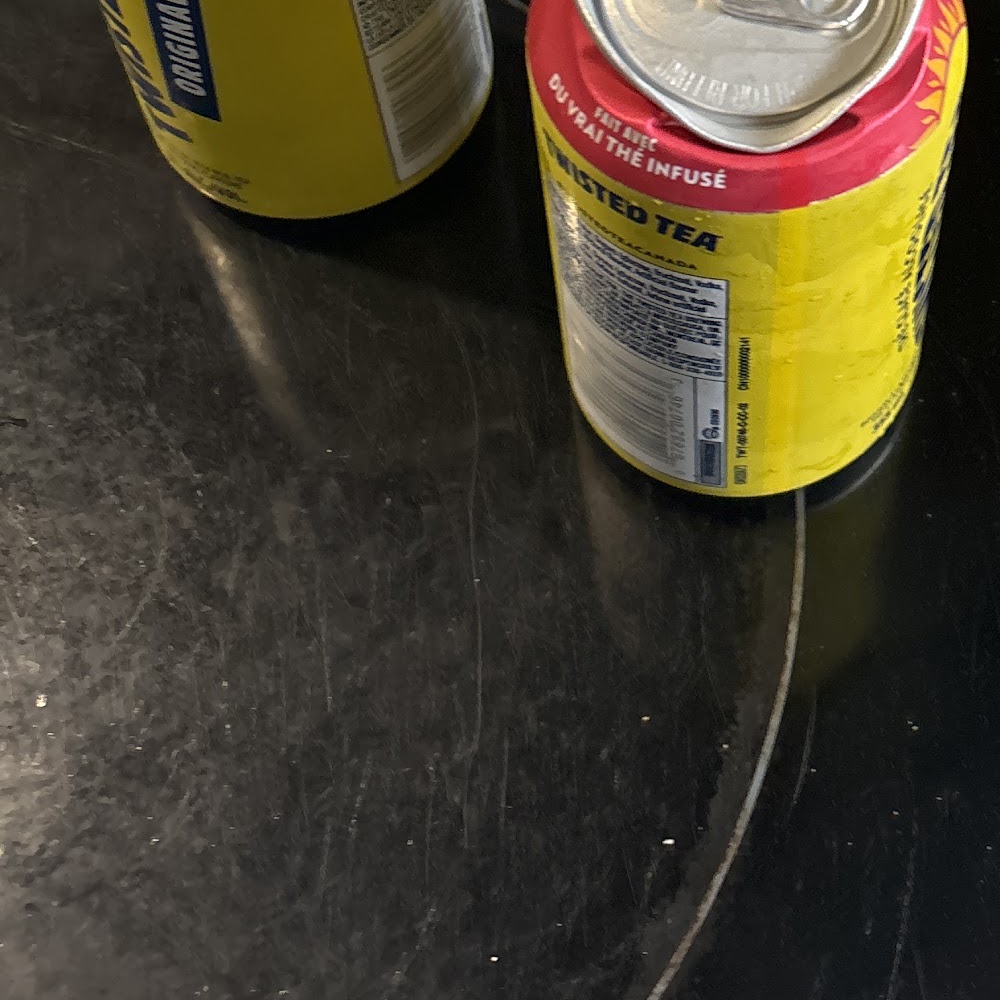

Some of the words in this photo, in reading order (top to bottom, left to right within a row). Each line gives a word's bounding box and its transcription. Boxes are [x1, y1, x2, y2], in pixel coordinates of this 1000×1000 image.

[542, 126, 649, 226] TWISTED
[655, 213, 725, 253] TEA
[548, 72, 570, 104] DU
[567, 99, 604, 145] VRAI
[605, 134, 644, 168] THÉ
[647, 157, 728, 190] INFUSÉ
